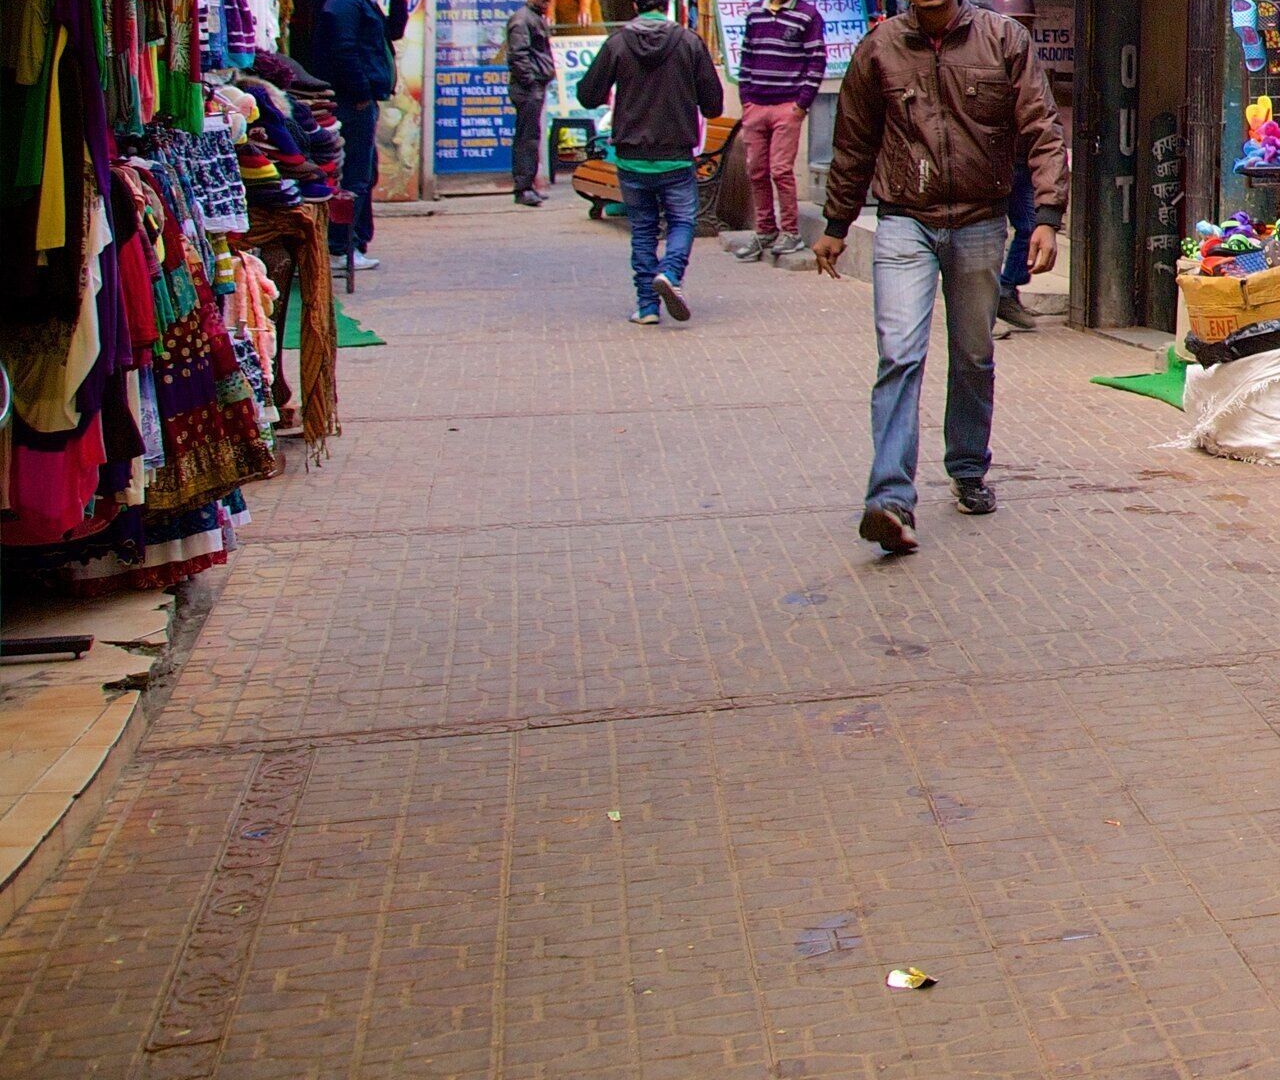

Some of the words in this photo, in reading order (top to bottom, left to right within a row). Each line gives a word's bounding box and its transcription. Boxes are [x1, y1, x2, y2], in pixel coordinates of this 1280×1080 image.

[437, 72, 470, 84] ENTRY
[441, 86, 459, 96] FREE
[461, 86, 492, 96] PADDLE
[461, 117, 492, 126] BATHING
[461, 127, 496, 137] NATURAL
[462, 148, 495, 158] TOILET
